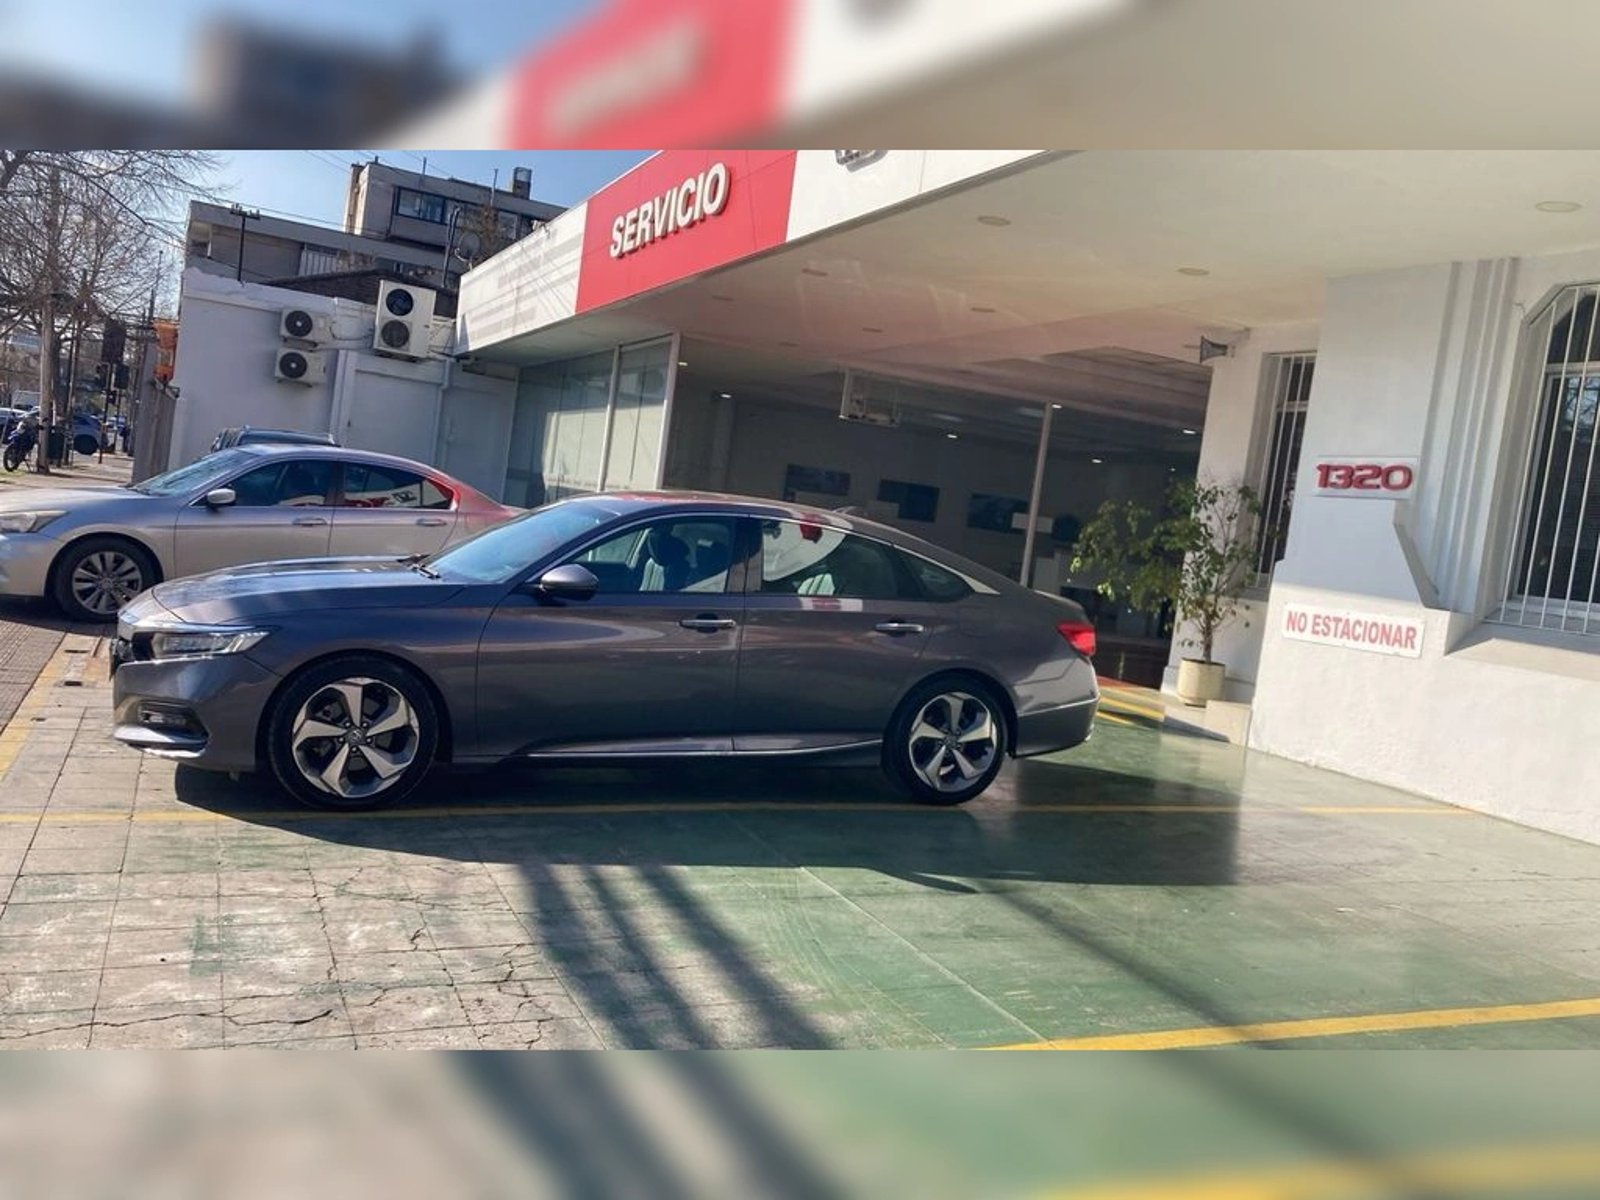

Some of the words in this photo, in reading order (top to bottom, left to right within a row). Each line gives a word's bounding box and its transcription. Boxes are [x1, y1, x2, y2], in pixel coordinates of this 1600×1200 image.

[609, 161, 730, 258] SERVICIO
[1316, 463, 1413, 491] 1320
[1286, 610, 1308, 633] NO
[1311, 613, 1417, 650] ESTACIONAR
